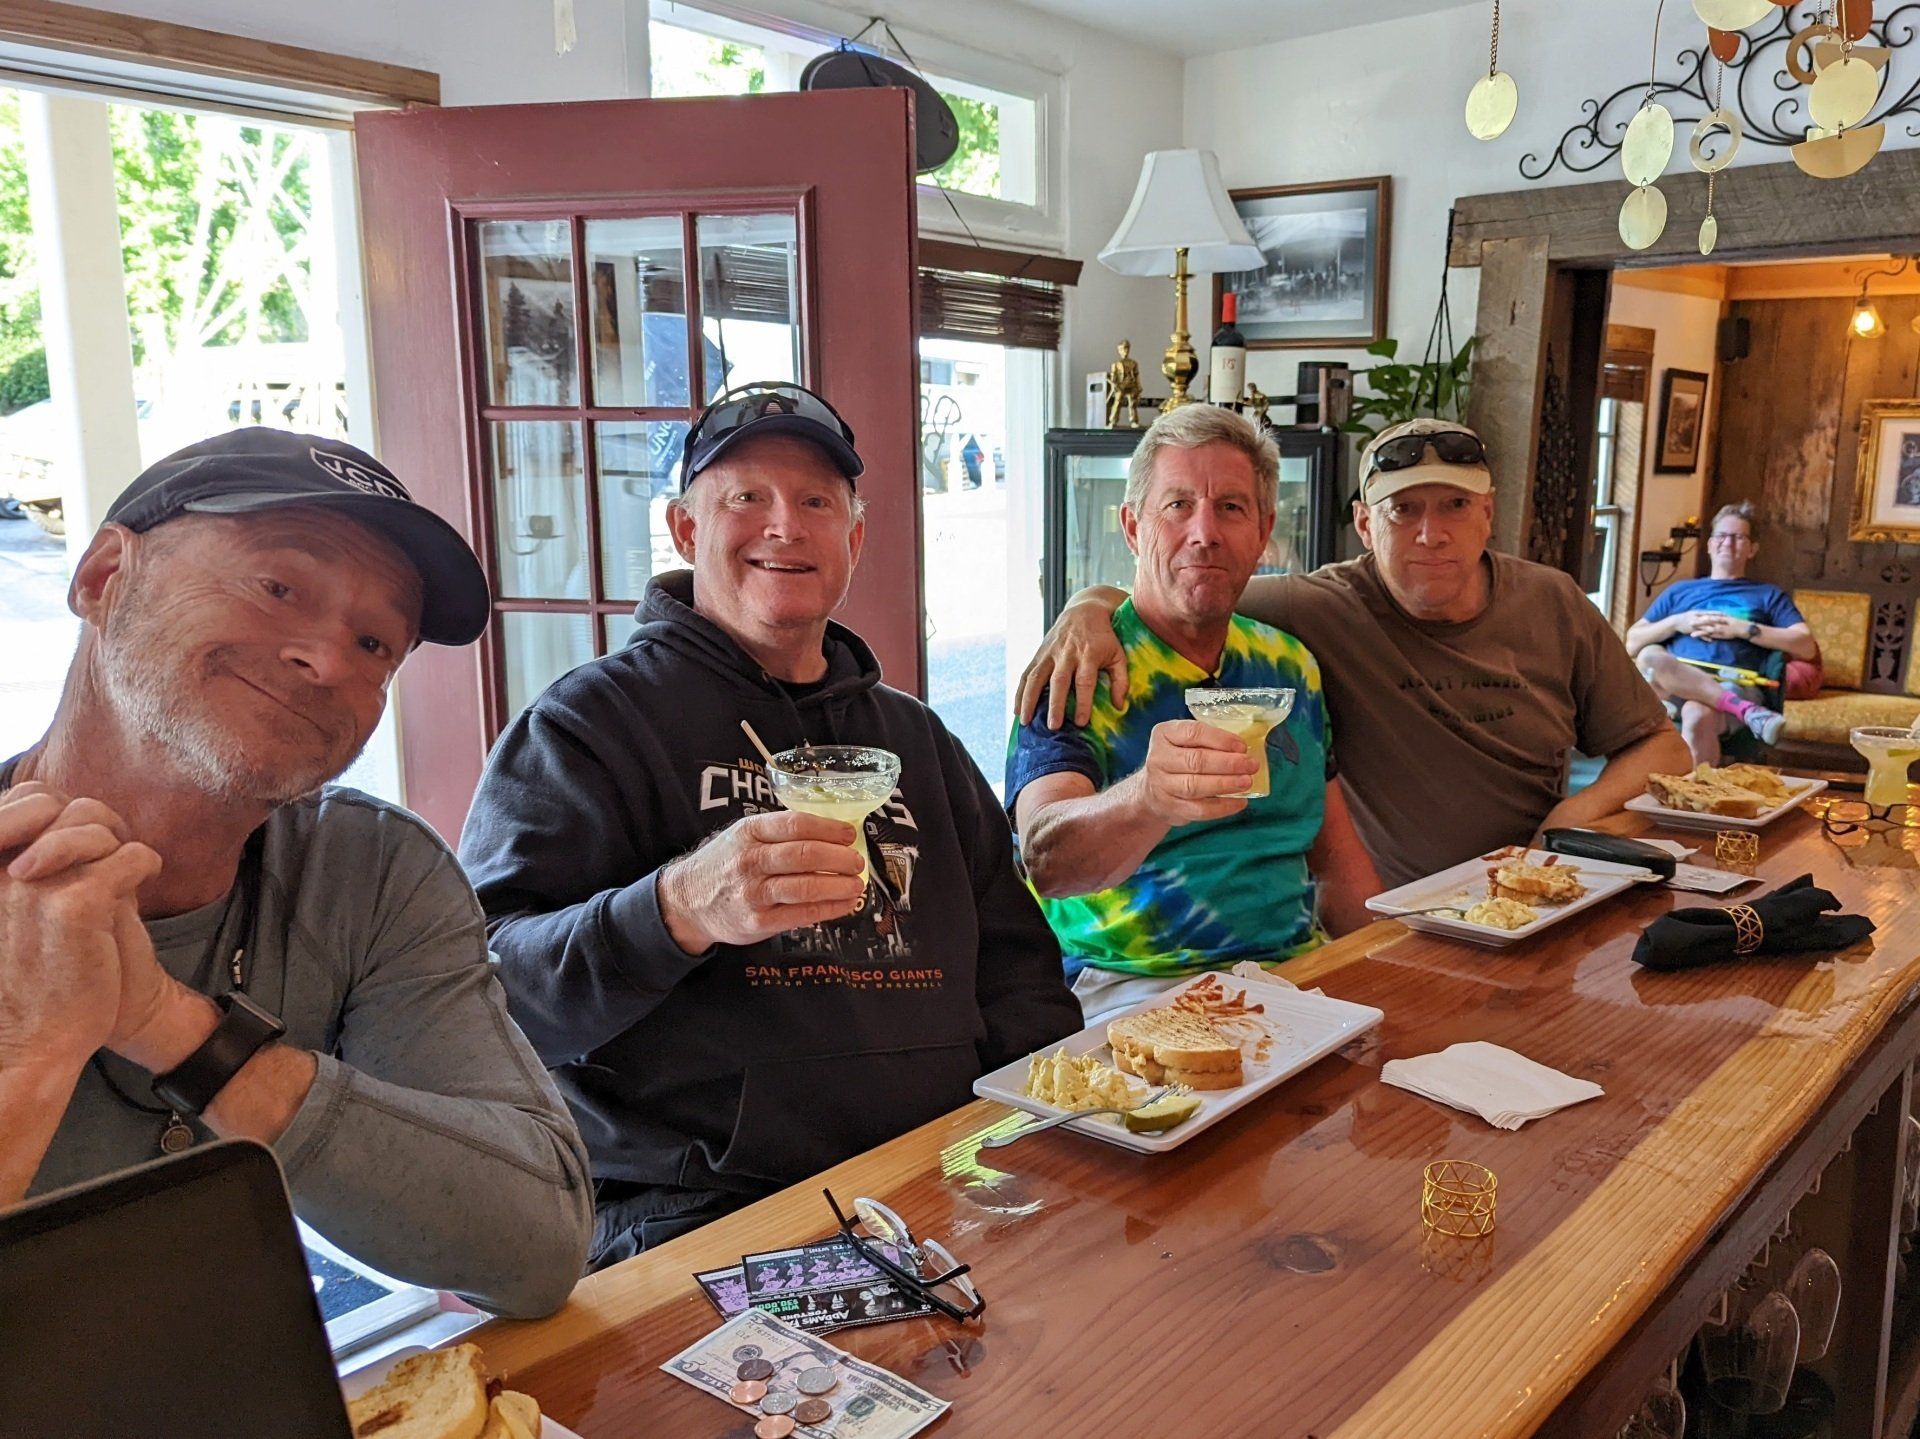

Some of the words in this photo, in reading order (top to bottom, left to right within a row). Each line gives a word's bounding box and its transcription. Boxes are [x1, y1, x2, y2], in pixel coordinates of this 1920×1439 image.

[745, 966, 782, 978] SAN
[889, 968, 943, 981] GIANTS
[801, 1309, 850, 1326] ADDAMS
